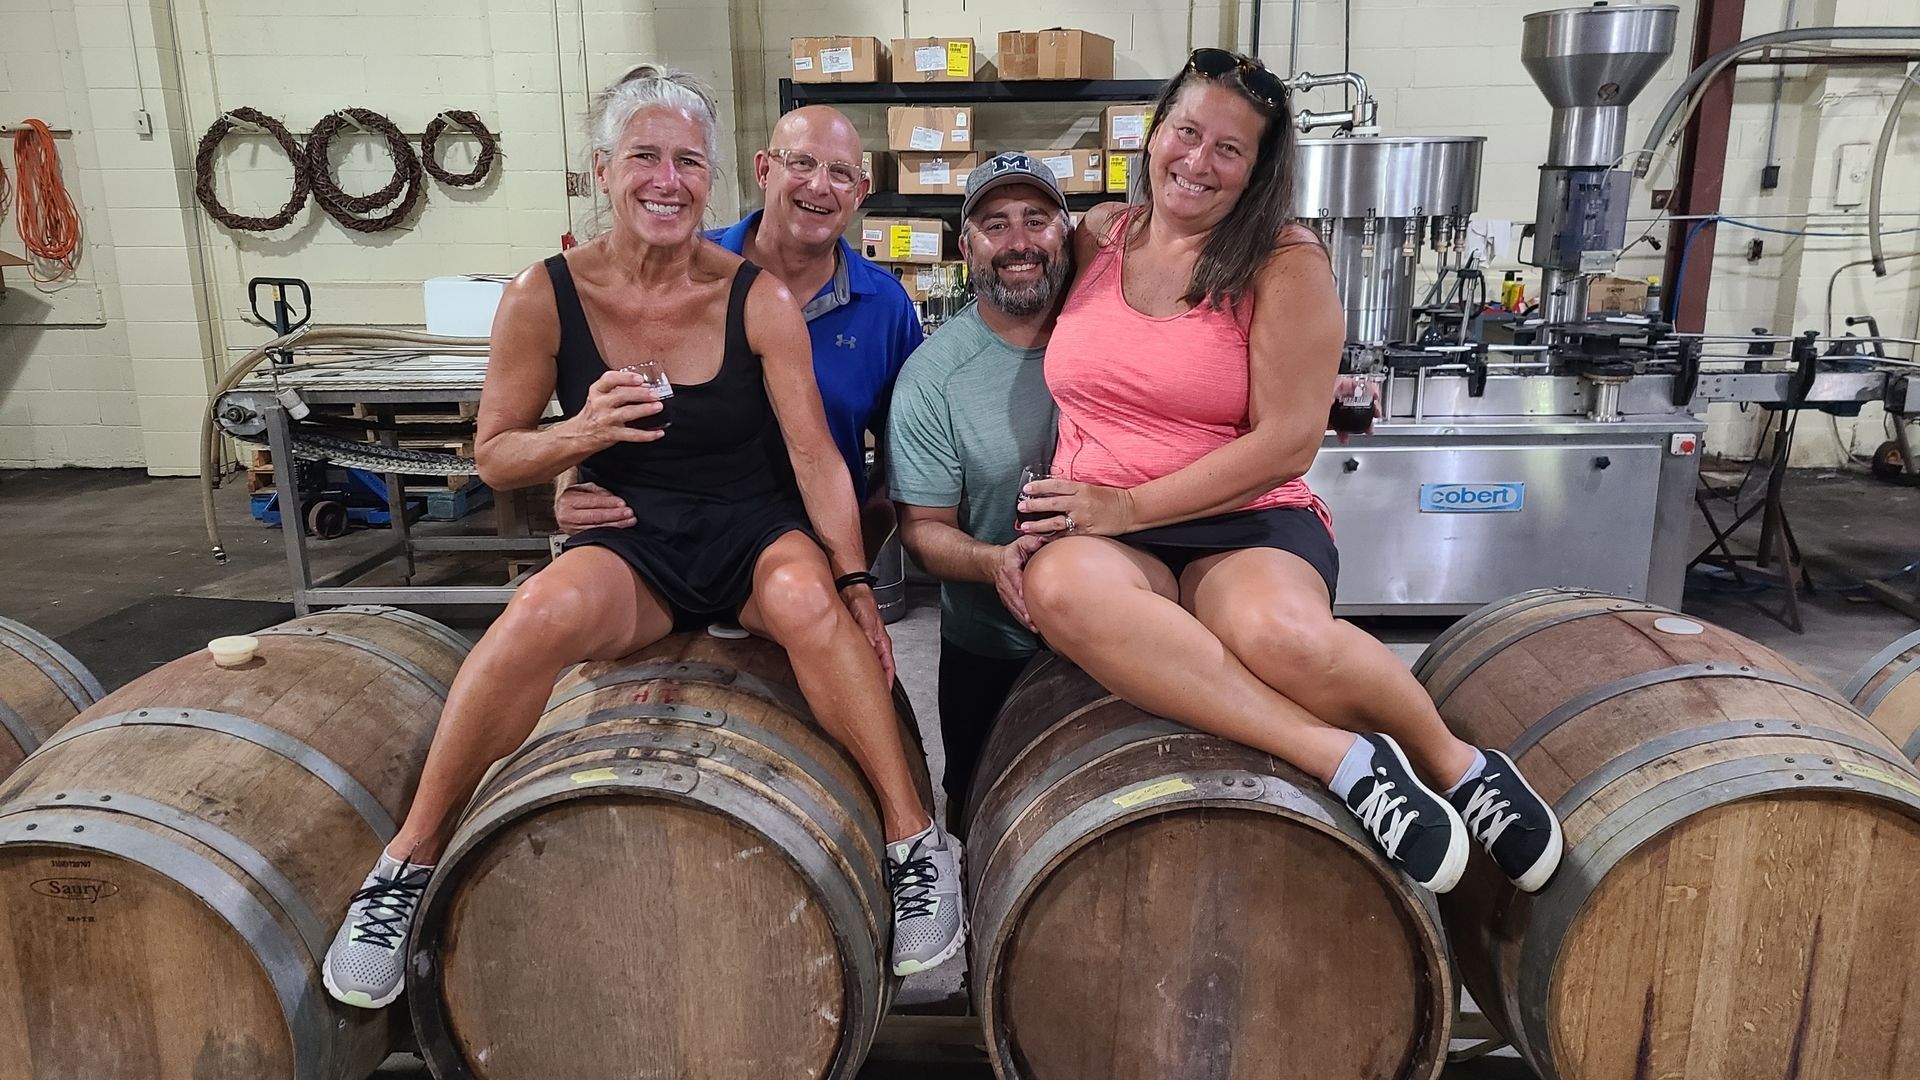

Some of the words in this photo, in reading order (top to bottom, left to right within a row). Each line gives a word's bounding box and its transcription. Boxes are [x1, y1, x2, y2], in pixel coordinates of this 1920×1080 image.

[992, 155, 1030, 174] M
[1318, 208, 1329, 217] 10
[1367, 208, 1376, 217] 11
[1412, 207, 1423, 216] 12
[1431, 488, 1508, 503] cobert
[49, 880, 100, 904] Saury
